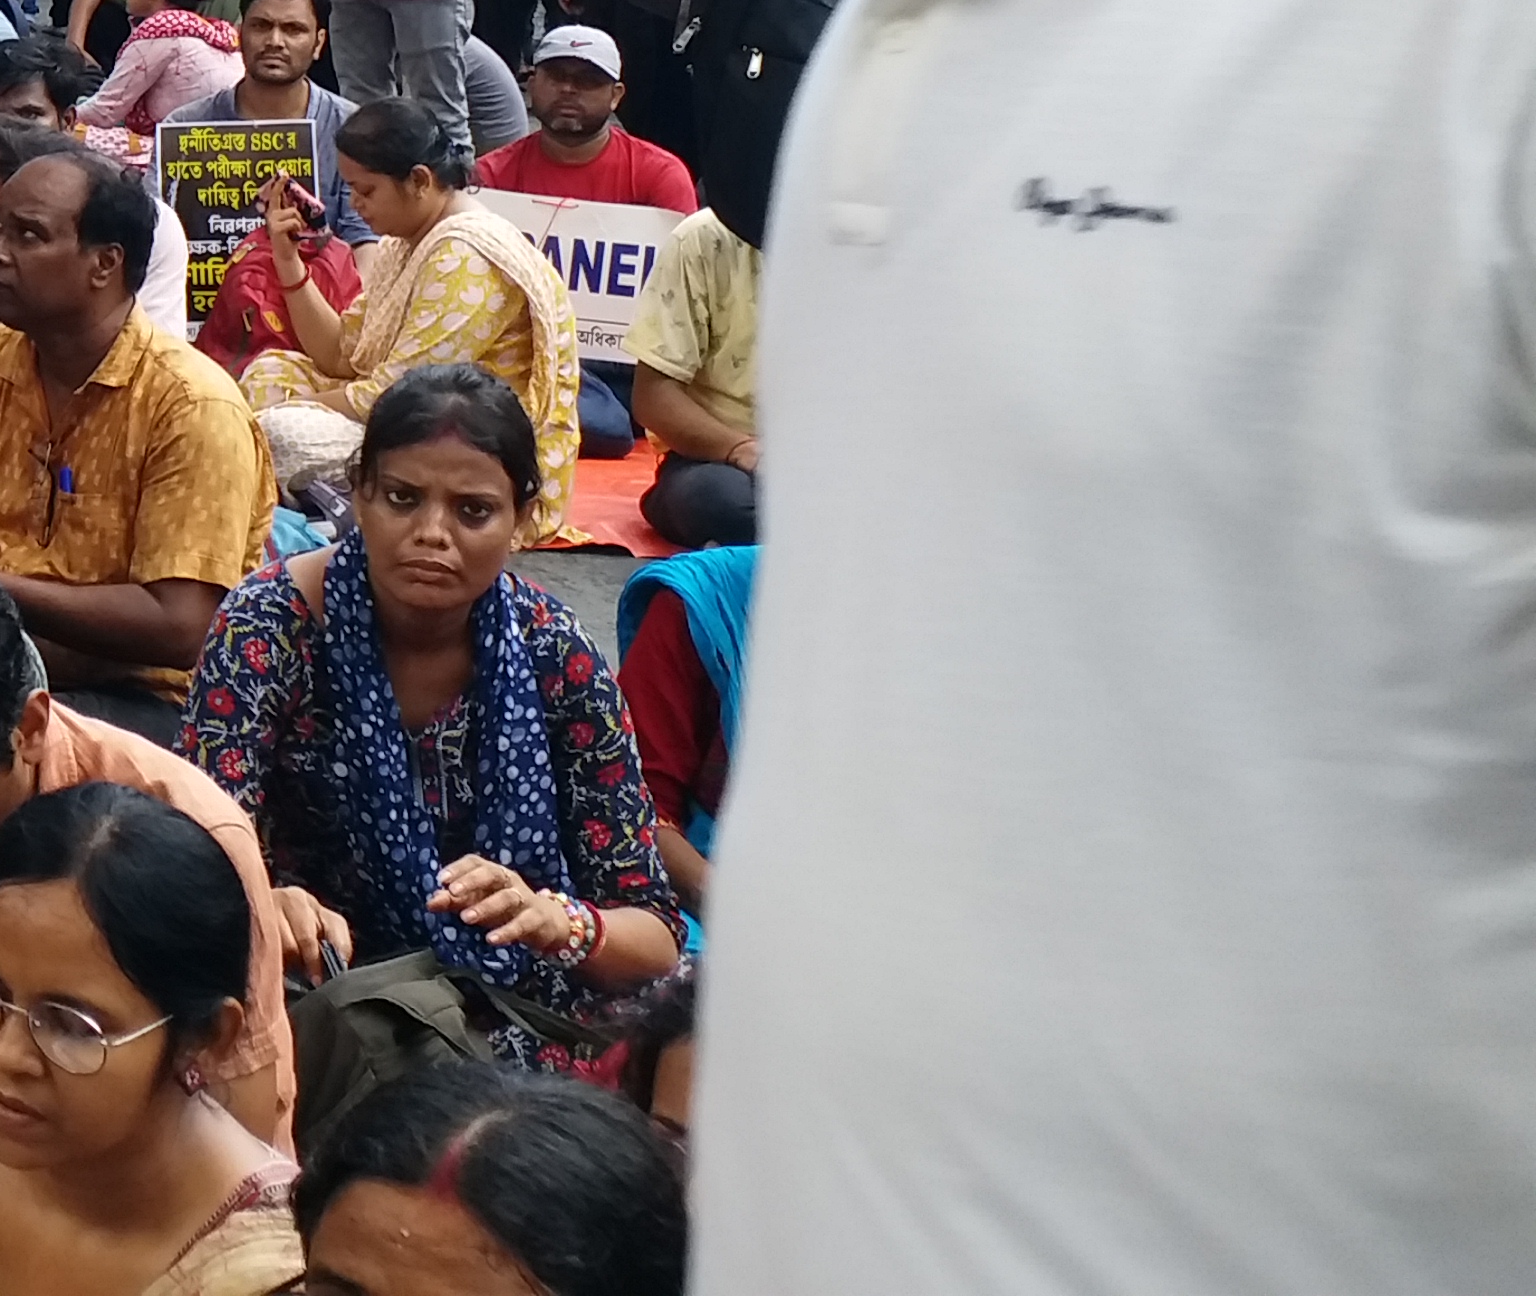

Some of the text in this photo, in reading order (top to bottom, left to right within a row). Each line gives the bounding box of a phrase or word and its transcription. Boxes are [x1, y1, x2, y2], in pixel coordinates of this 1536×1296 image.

[250, 132, 283, 151] SSC
[166, 160, 203, 180] হাতে
[206, 154, 251, 179] পরীক্ষা
[522, 232, 656, 298] ANE
[577, 326, 626, 350] অধিকা
